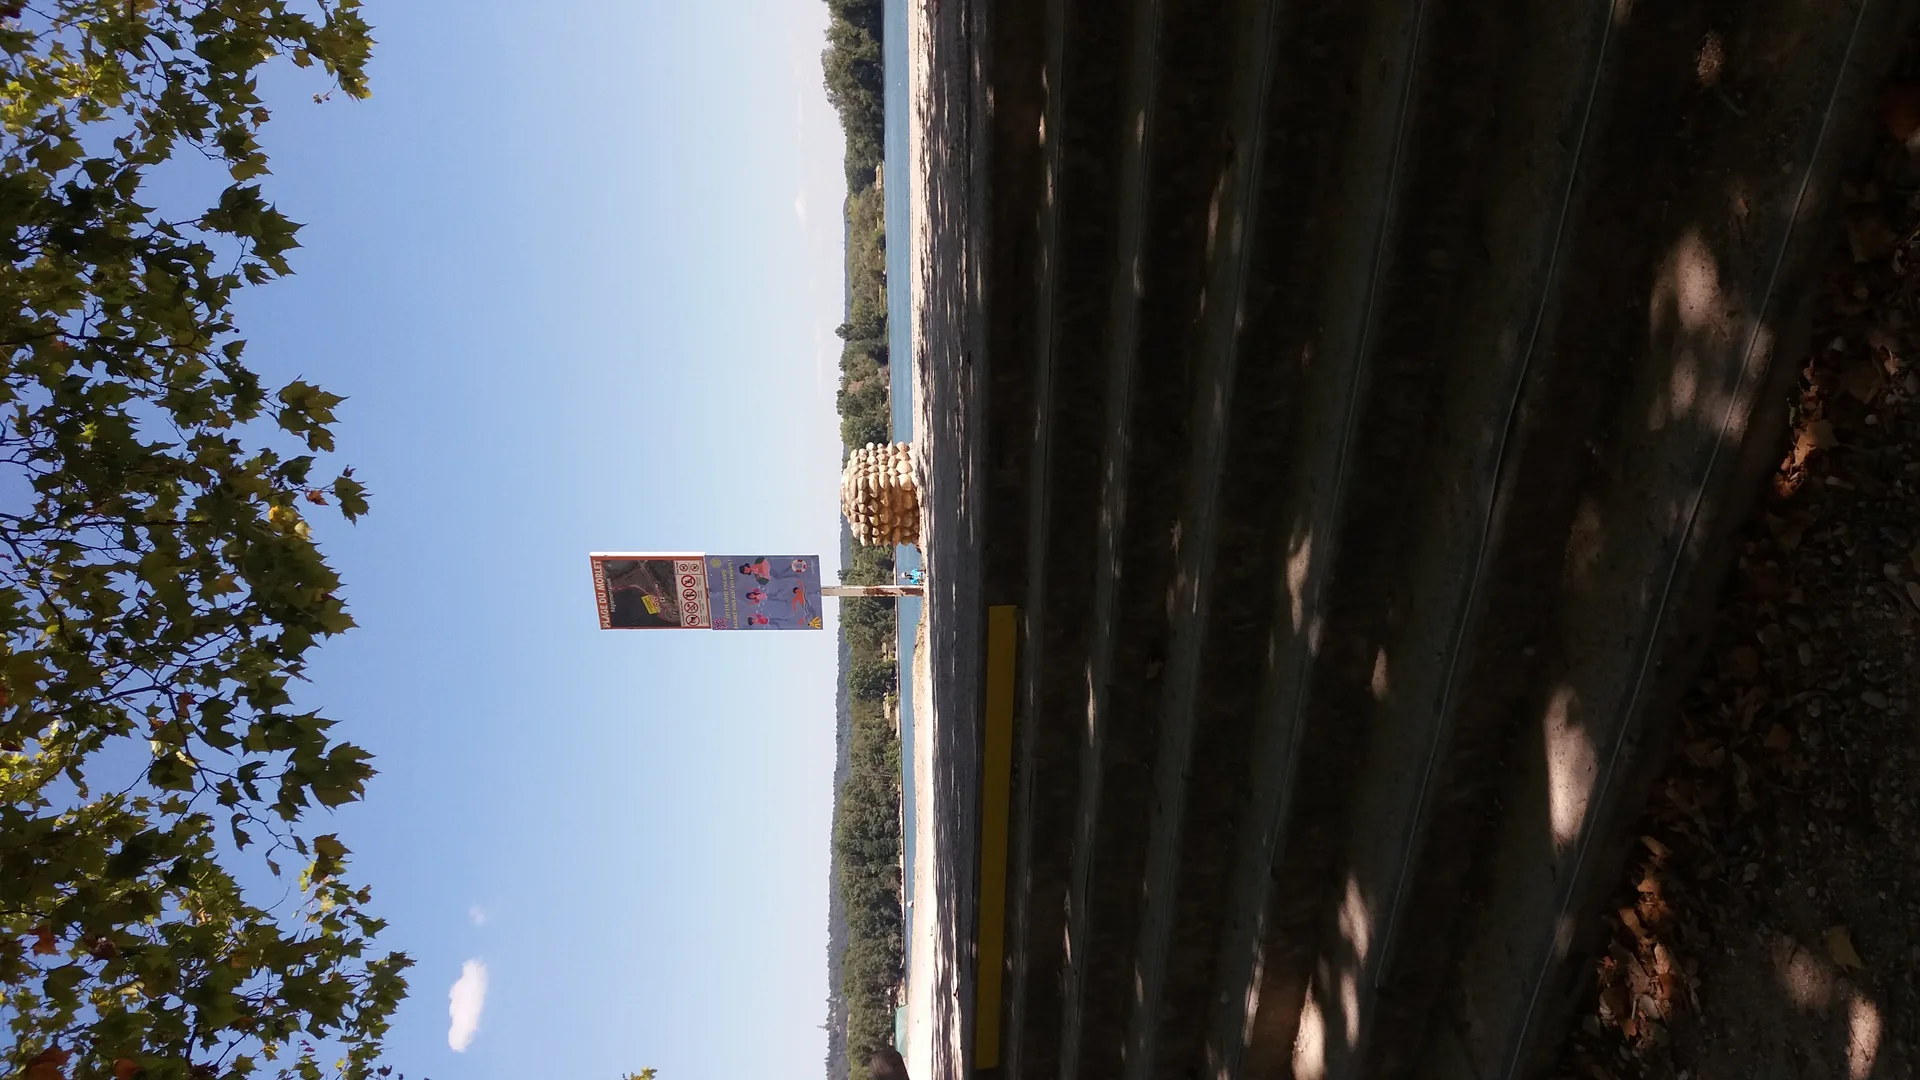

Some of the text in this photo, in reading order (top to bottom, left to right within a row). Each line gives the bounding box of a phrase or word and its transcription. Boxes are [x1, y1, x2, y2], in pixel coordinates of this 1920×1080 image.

[593, 560, 611, 628] PLAGE DU MORLET
